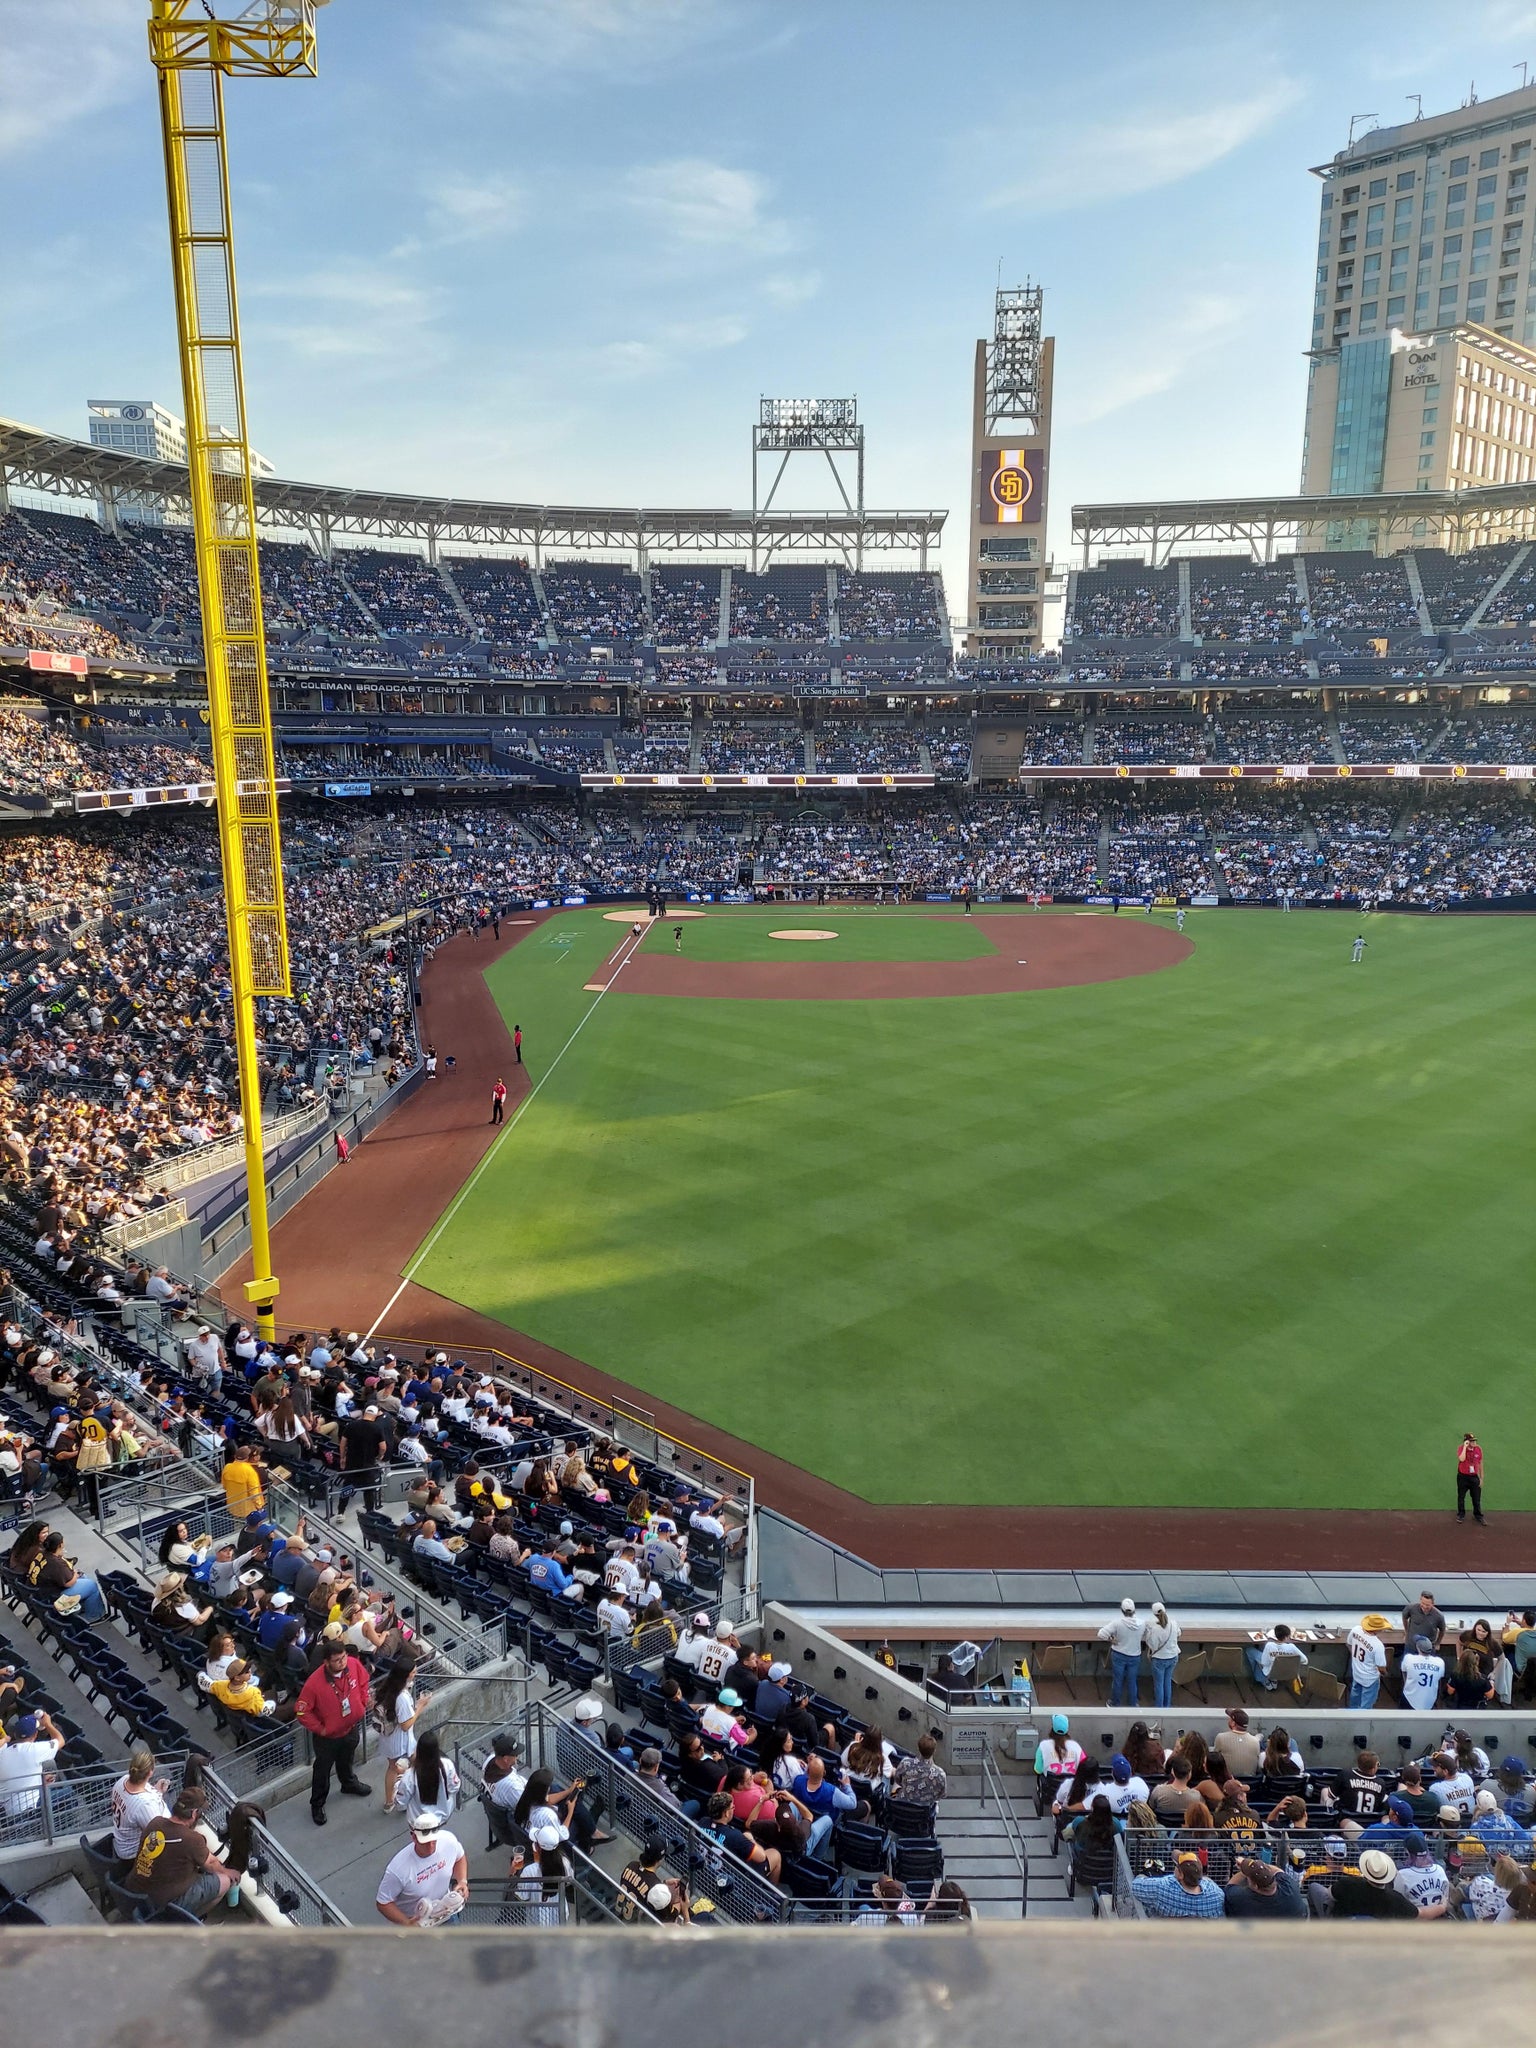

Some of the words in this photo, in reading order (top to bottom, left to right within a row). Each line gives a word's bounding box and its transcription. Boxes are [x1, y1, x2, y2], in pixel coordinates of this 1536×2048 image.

[1408, 352, 1436, 365] OMNI
[1404, 373, 1438, 387] HOTEL
[1000, 471, 1023, 502] SD
[269, 681, 296, 689] ERRY
[301, 682, 352, 690] COLEMAN
[356, 683, 422, 694] BROADCAST
[427, 685, 471, 695] CENTER
[822, 687, 840, 696] Diego
[841, 687, 861, 695] Health
[1096, 896, 1113, 904] petco
[1125, 896, 1144, 904] petco
[647, 1552, 656, 1570] 5
[706, 1644, 721, 1655] TATIS
[1352, 1632, 1374, 1653] MACHADO
[1353, 1644, 1365, 1663] 13
[703, 1656, 722, 1678] 23
[1413, 1663, 1440, 1672] PEDERSON
[1418, 1673, 1434, 1687] 31
[1349, 1778, 1382, 1794] MACHADO
[1446, 1788, 1473, 1801] MERRILL
[1356, 1791, 1375, 1813] 13
[622, 1867, 642, 1888] TATIS
